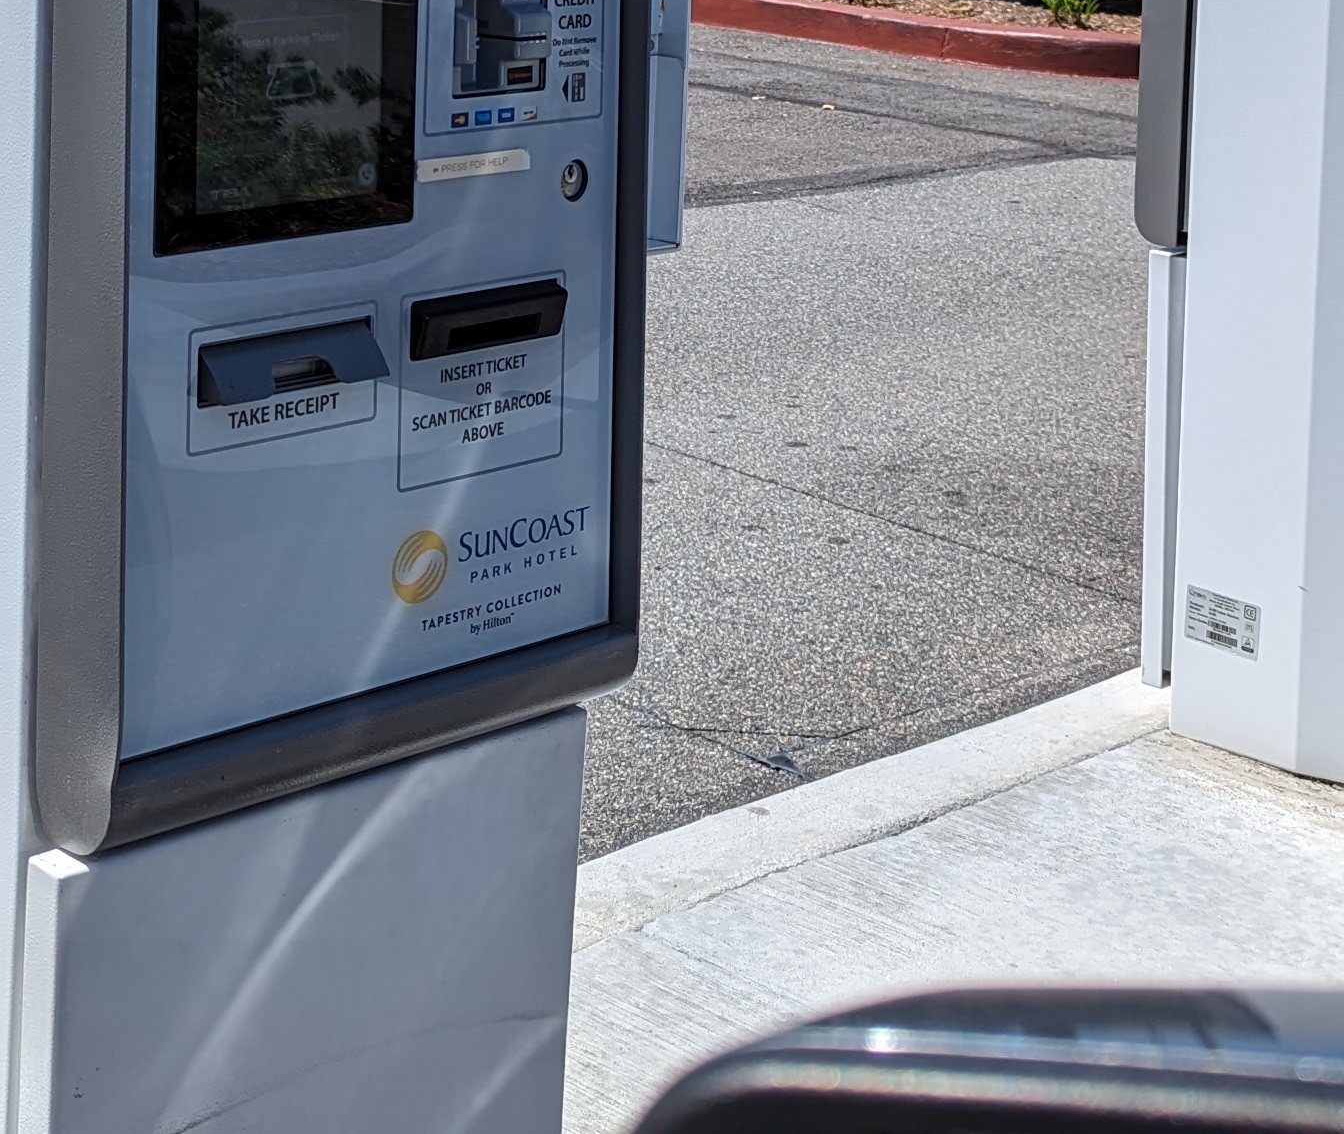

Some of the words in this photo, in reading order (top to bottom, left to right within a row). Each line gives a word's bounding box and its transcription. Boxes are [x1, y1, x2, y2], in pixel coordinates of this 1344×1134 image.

[558, 13, 592, 29] CARD
[552, 38, 561, 47] Do
[574, 36, 597, 45] Remove
[559, 48, 573, 57] Card
[559, 59, 589, 68] Processing
[441, 162, 467, 173] PRESS
[470, 160, 485, 170] FOR
[488, 156, 508, 168] HELP
[440, 362, 484, 383] INSERT
[487, 354, 527, 376] TICKET
[476, 381, 491, 395] OR
[228, 406, 270, 429] TAKE
[274, 392, 340, 421] RECEIPT
[412, 411, 447, 432] SCAN
[449, 402, 492, 423] TICKET
[494, 390, 552, 414] BARCODE
[462, 421, 504, 444] ABOVE
[470, 562, 512, 583] PARK
[524, 545, 578, 569] HOTEL
[422, 605, 482, 631] TAPESTRY
[486, 584, 562, 615] COLLECTION
[470, 623, 481, 635] by
